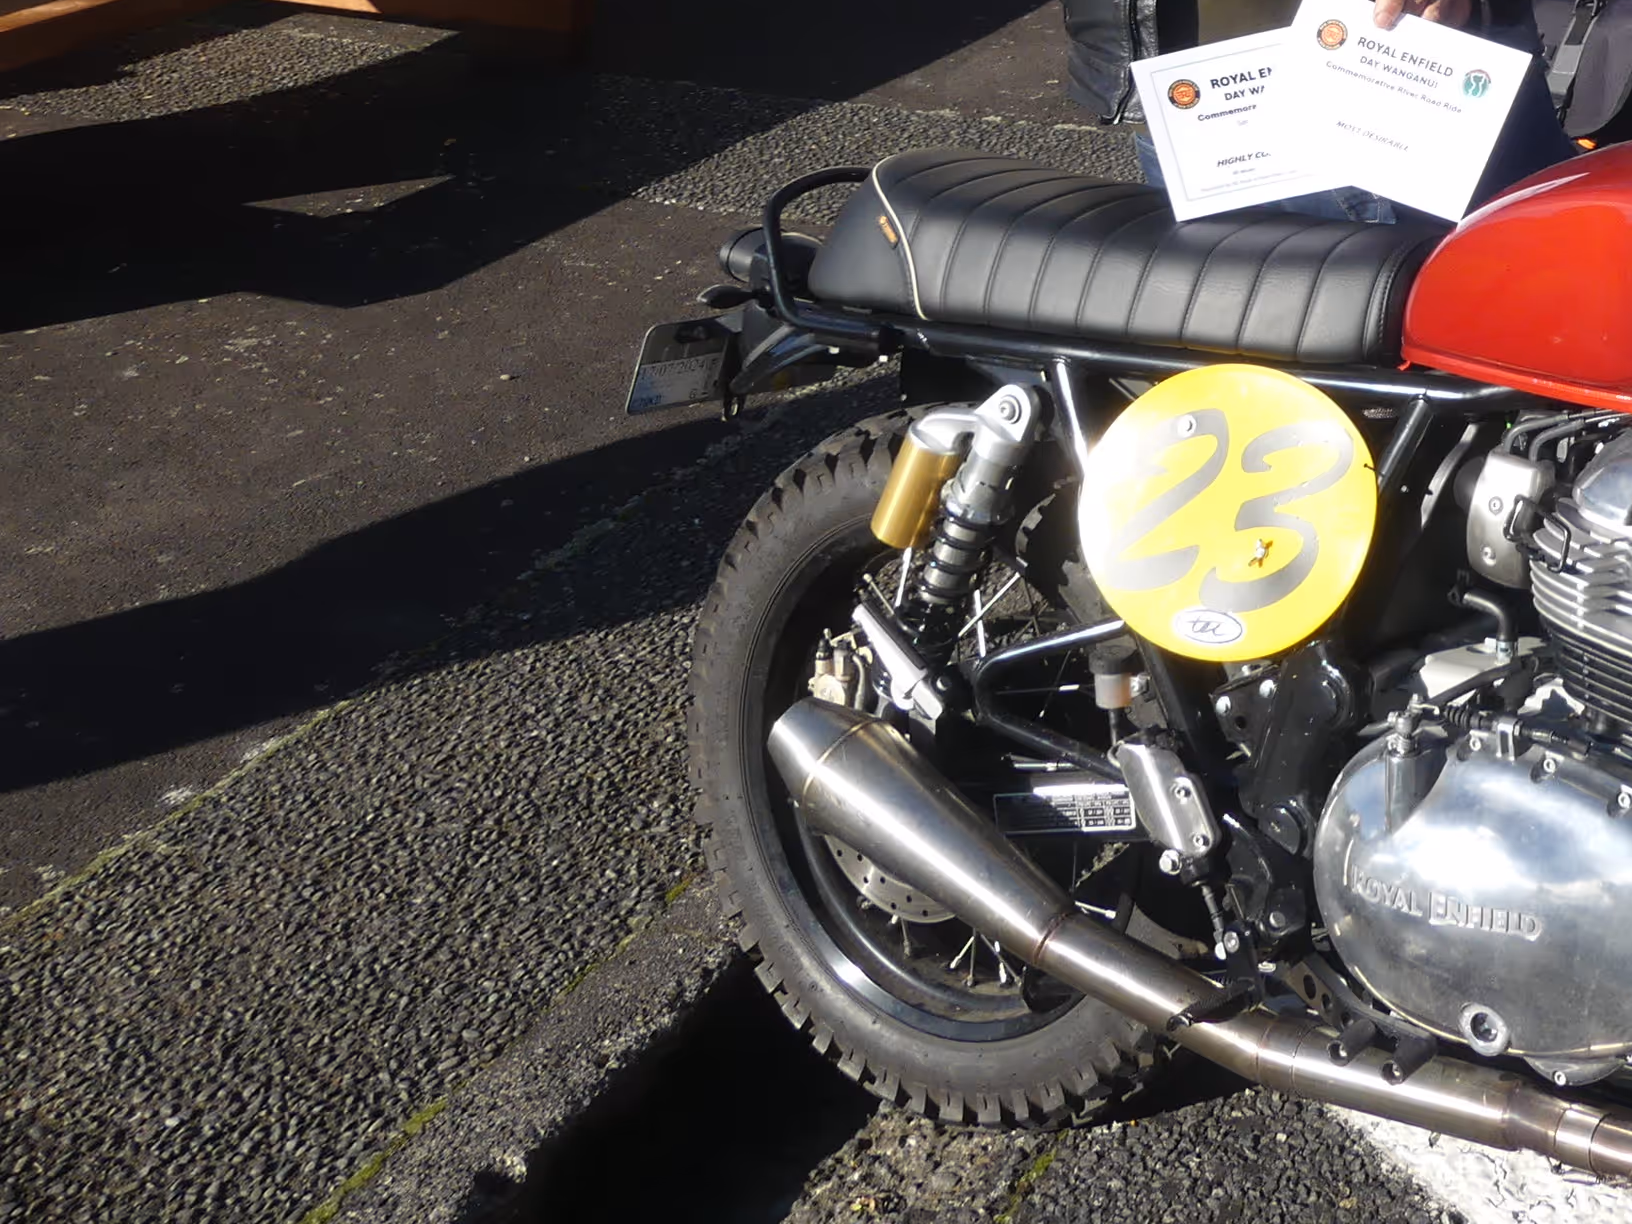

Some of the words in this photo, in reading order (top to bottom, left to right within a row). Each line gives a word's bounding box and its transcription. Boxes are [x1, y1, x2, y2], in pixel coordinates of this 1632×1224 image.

[1357, 36, 1398, 59] ROYAL
[1400, 52, 1454, 77] ENFIELD
[1359, 55, 1381, 69] DAY
[1383, 63, 1439, 89] WANGANUI
[1209, 71, 1256, 89] ROYAL
[1224, 89, 1247, 101] DAY
[1326, 60, 1395, 91] Commemorative
[1420, 93, 1442, 107] Road
[1443, 102, 1462, 114] Ride
[1216, 153, 1254, 168] HIGHLY
[1100, 408, 1354, 613] 23
[1351, 864, 1423, 918] ROYAL
[1428, 891, 1544, 943] ENFIELD
